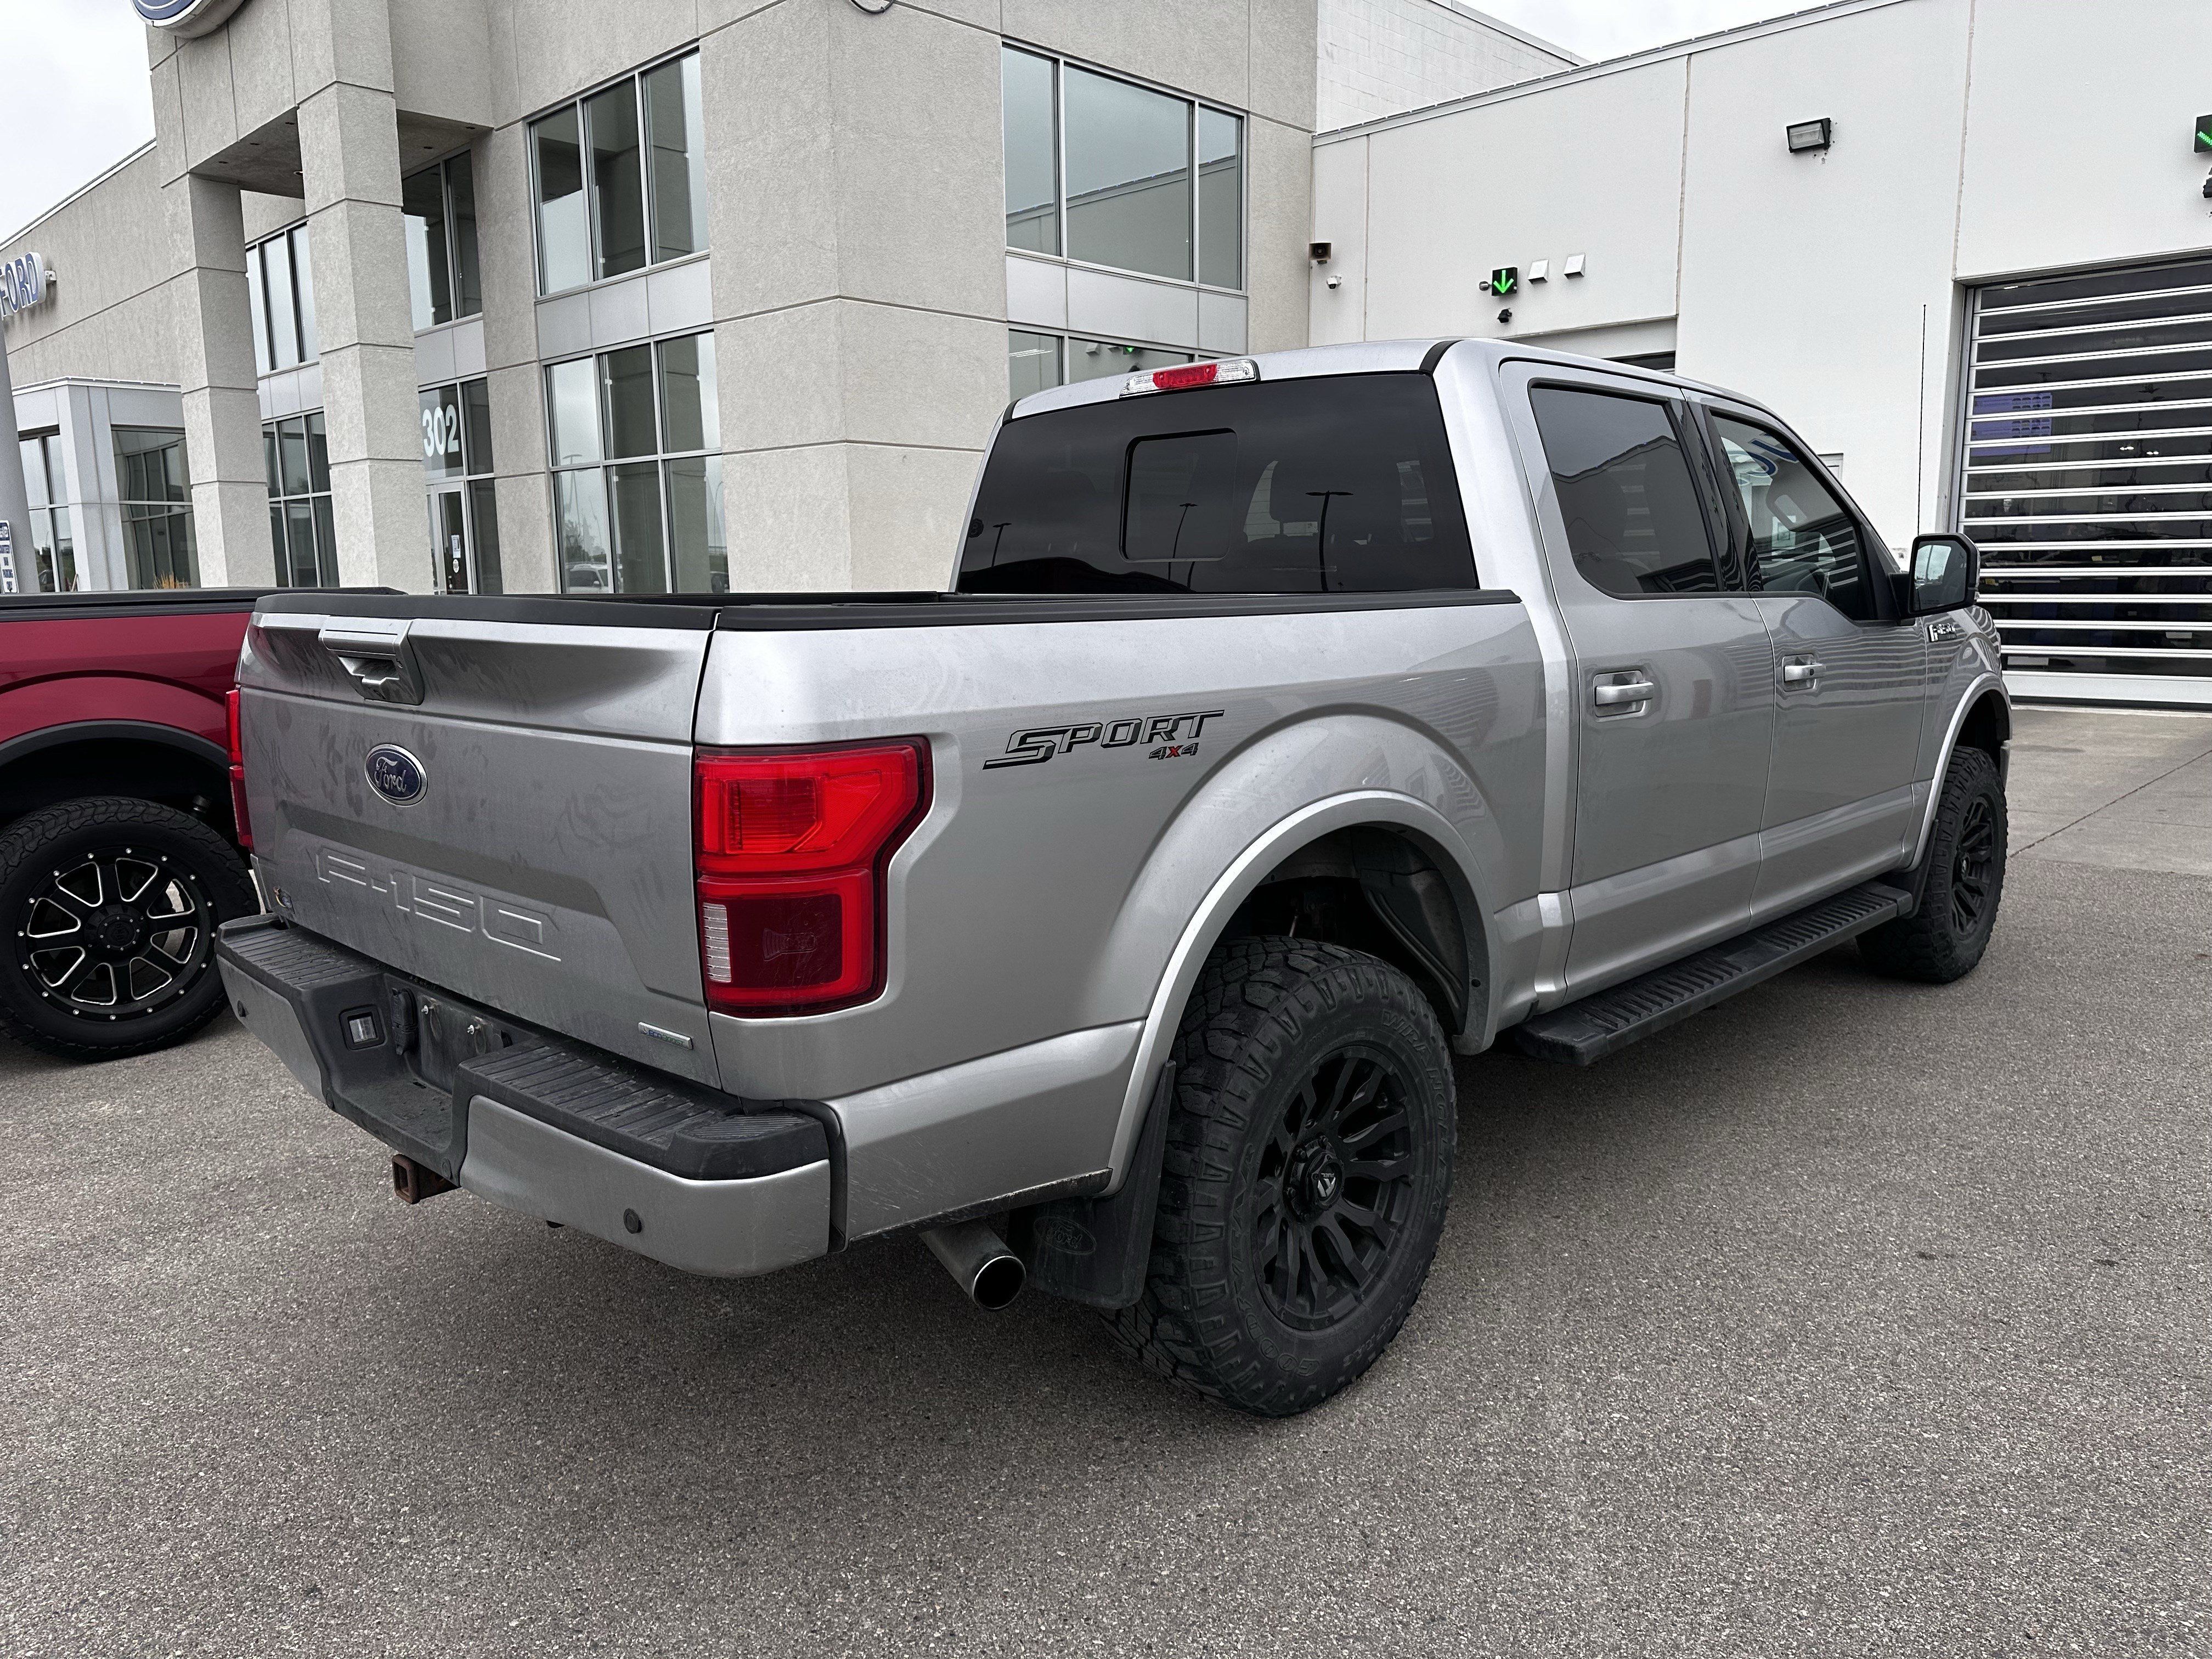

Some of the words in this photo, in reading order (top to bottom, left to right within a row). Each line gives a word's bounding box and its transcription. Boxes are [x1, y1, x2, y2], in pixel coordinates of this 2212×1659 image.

[422, 404, 459, 457] 302
[982, 709, 1224, 770] SPORT
[374, 756, 407, 793] Ford
[315, 846, 562, 962] F-150
